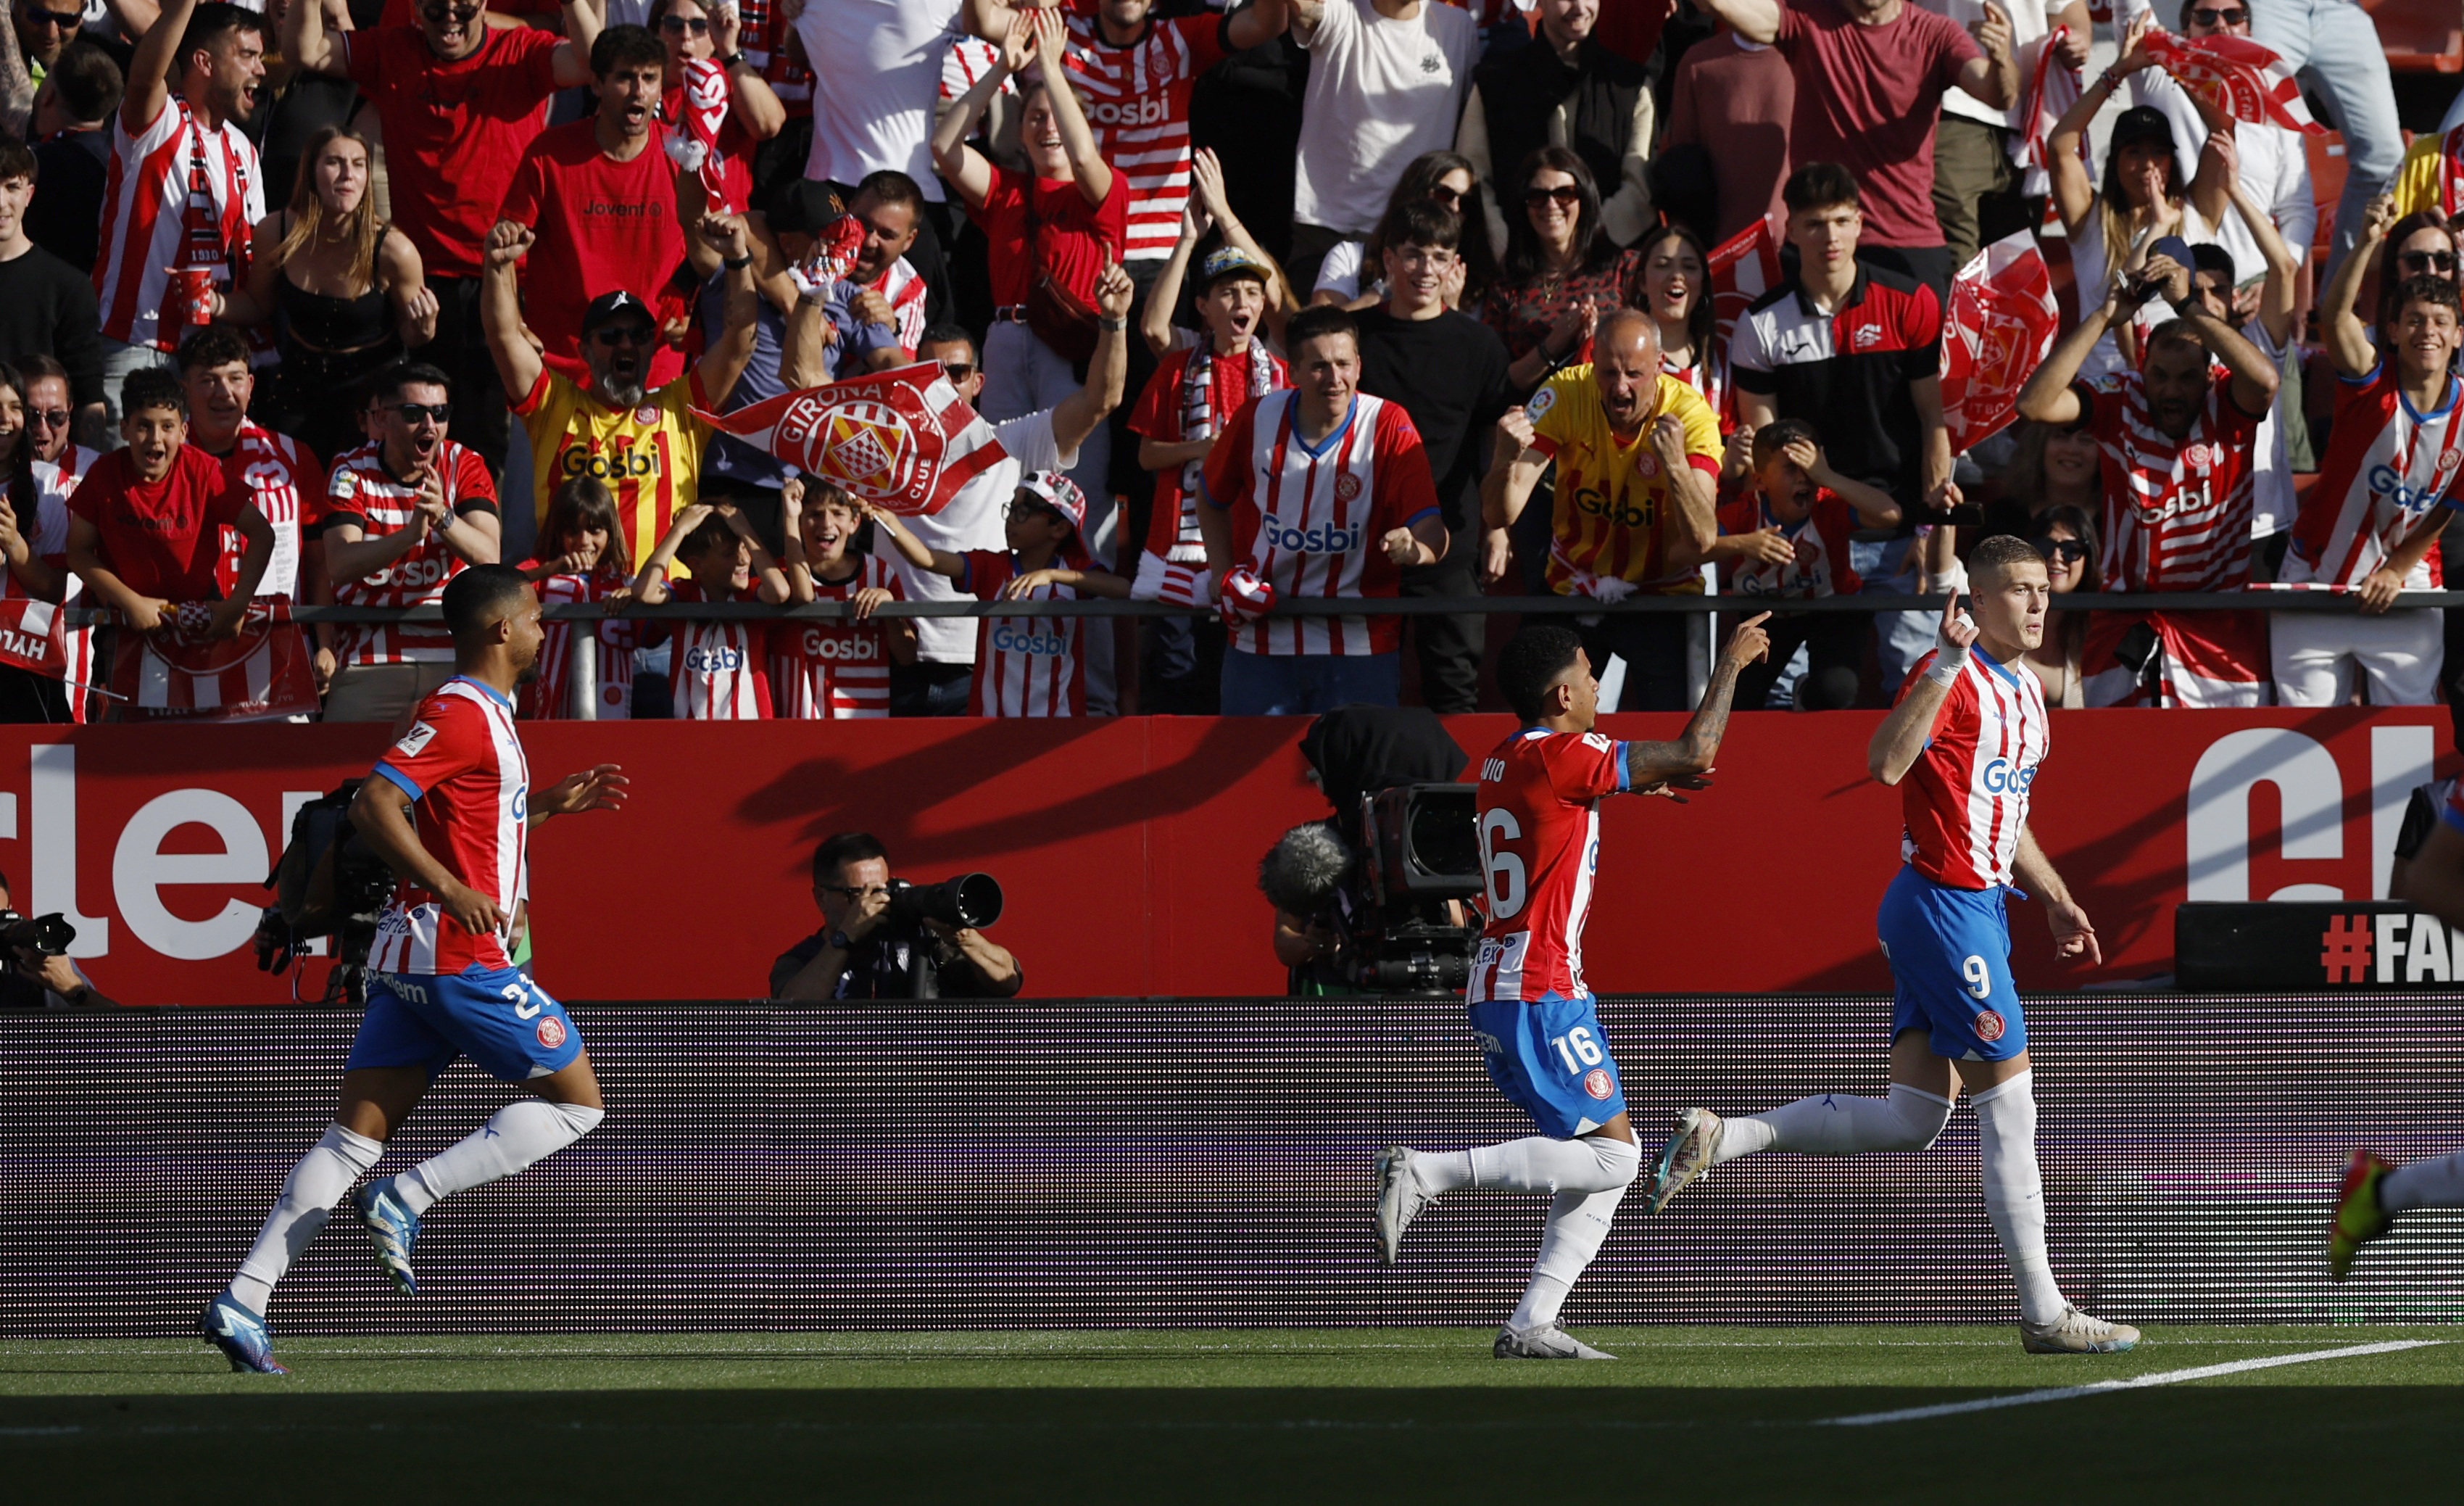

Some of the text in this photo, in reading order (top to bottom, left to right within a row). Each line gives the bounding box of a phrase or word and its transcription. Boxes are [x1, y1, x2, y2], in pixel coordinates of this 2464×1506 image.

[781, 384, 882, 443] GIRONA
[563, 444, 659, 479] Gosbi
[1262, 514, 1360, 553] Gosbi
[803, 628, 879, 660] Gosbi
[993, 626, 1068, 655] Gosbi
[1481, 758, 1505, 782] VIO
[501, 973, 552, 1020] 21
[1963, 955, 1991, 999] 9
[1551, 1027, 1602, 1075] 16
